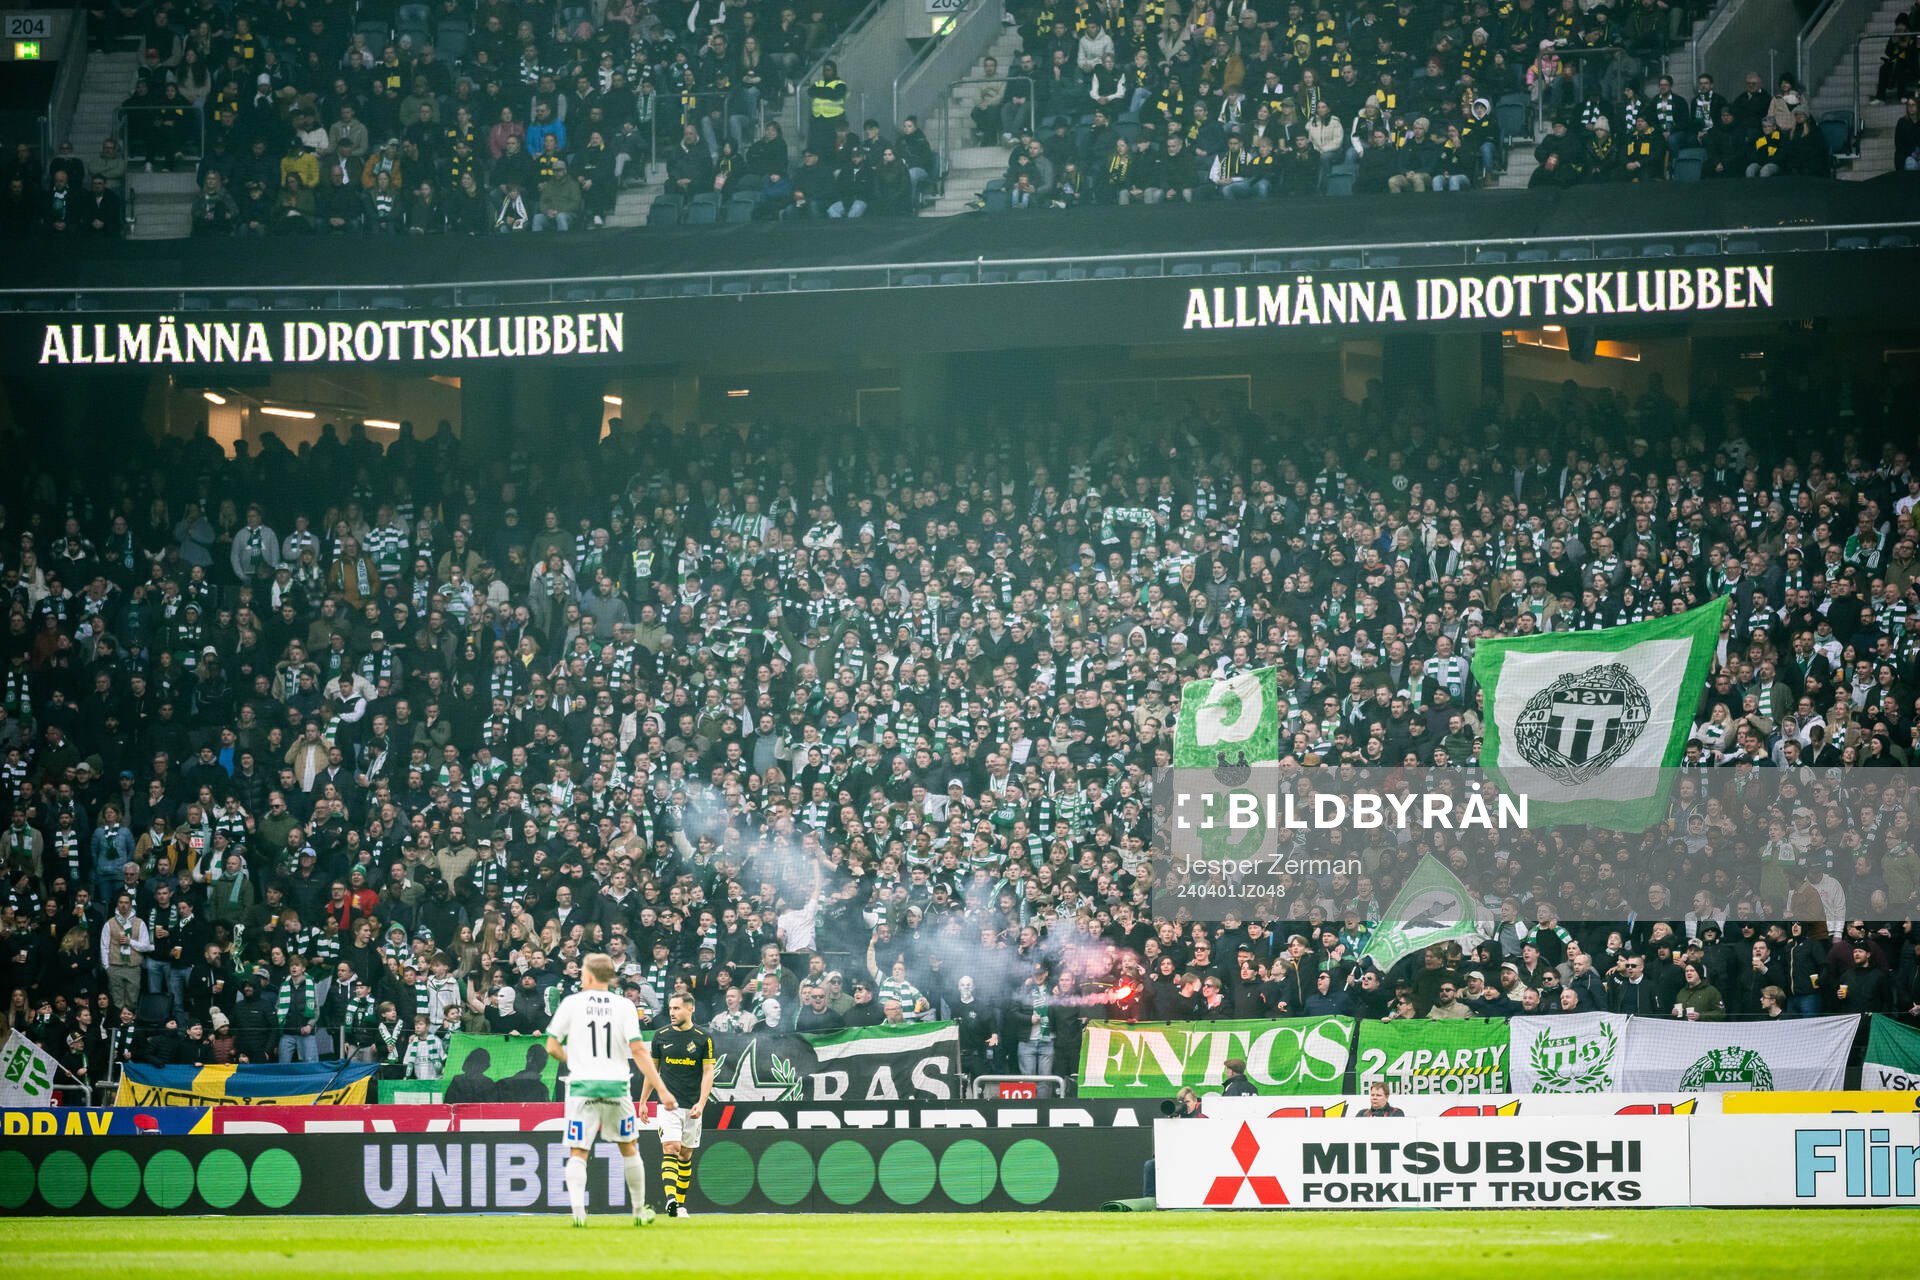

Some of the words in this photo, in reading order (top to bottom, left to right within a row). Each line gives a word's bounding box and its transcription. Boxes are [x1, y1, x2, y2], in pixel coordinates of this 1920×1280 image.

[12, 19, 44, 34] 204
[1183, 276, 1407, 329] ALLMÄNNA
[1416, 265, 1774, 321] IDROTTSKLUBBEN
[38, 316, 273, 364] ALLMÄNNA
[283, 312, 624, 362] IDROTTSKLUBBEN
[587, 1020, 612, 1059] 11
[1548, 1039, 1571, 1047] VSK
[665, 1056, 696, 1066] truecaller
[1360, 1048, 1415, 1078] 24
[1413, 1044, 1507, 1070] PARTY
[1412, 1071, 1503, 1095] PEOPLE
[1714, 1070, 1744, 1082] VSK
[1302, 1140, 1642, 1175] MITSUBISHI
[363, 1143, 640, 1208] UNIBET
[1302, 1181, 1477, 1203] FORKLIFT
[1488, 1180, 1642, 1202] TRUCKS
